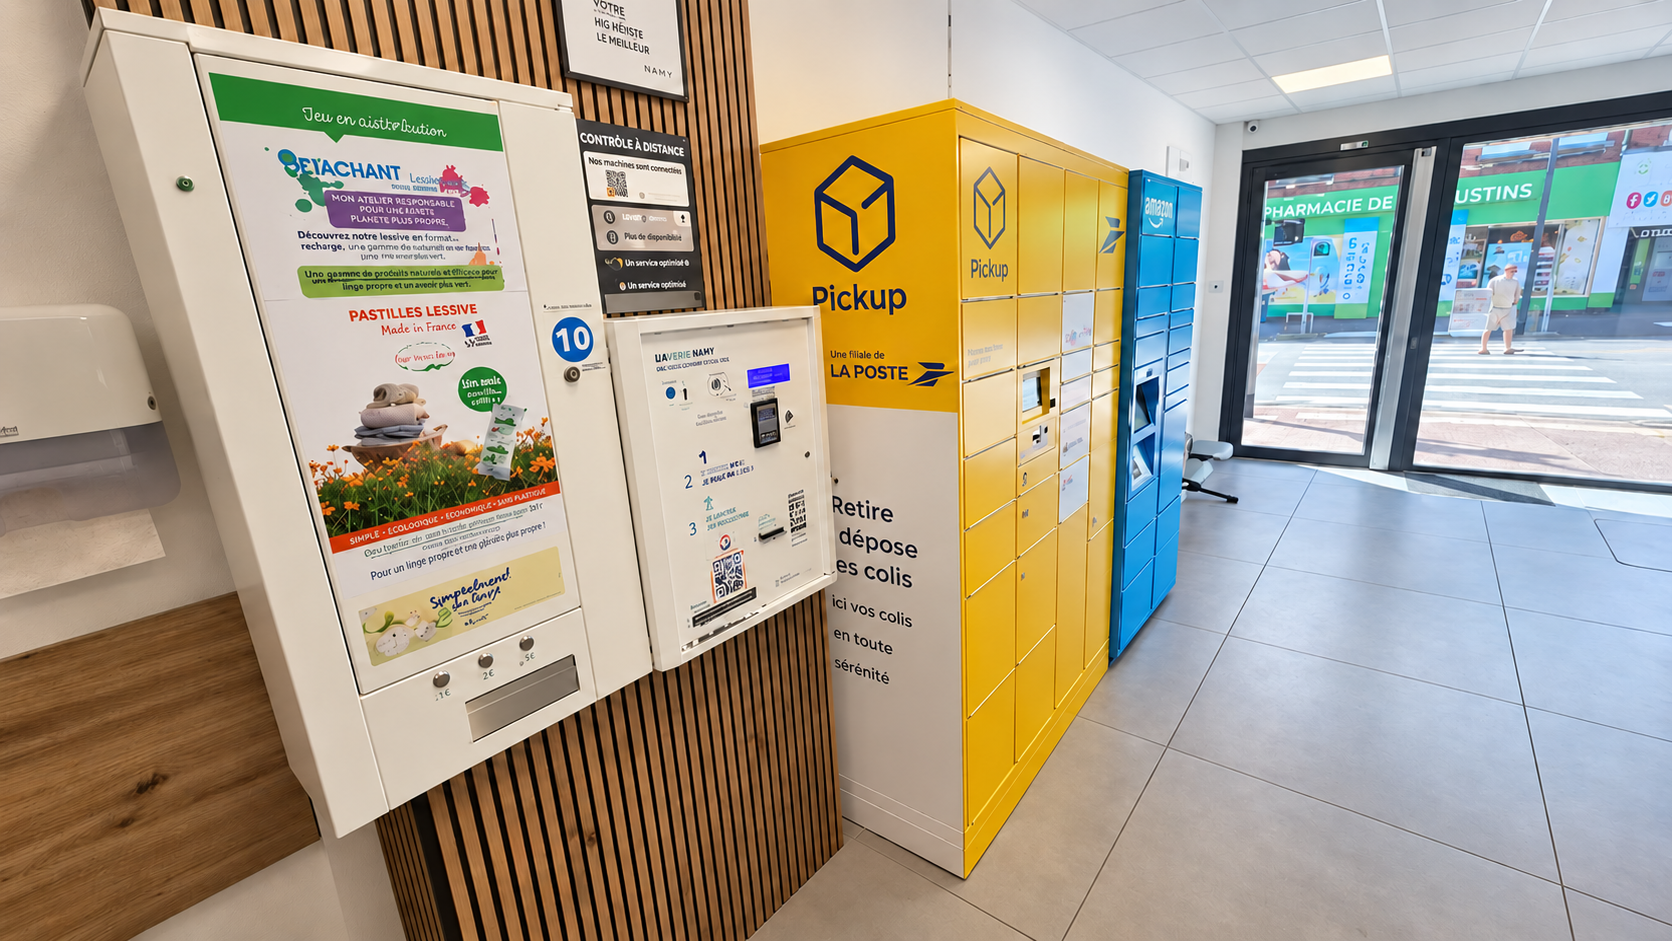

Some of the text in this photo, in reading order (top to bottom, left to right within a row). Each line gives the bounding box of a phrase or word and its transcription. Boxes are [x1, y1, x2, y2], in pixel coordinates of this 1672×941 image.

[593, 0, 625, 16] VOTRE
[596, 32, 650, 55] LE MEILLEUR
[644, 65, 672, 78] NAMY
[336, 114, 356, 126] en
[580, 132, 685, 157] CONTRÔLE À DISTANCE
[588, 156, 602, 166] Nos
[604, 160, 635, 170] machines
[636, 163, 650, 171] sont
[331, 194, 355, 203] MON
[358, 196, 393, 205] ATELIER
[1265, 196, 1394, 218] PHARMACIE DE
[360, 206, 384, 214] POUR
[1145, 197, 1173, 219] amazon
[297, 230, 350, 240] Découvrez
[380, 232, 410, 241] lessive
[624, 232, 637, 240] Plus
[625, 259, 634, 267] Un
[636, 259, 658, 267] service
[971, 258, 1008, 282] Pickup
[366, 283, 393, 291] propre
[628, 282, 638, 290] Un
[638, 281, 660, 289] service
[812, 284, 907, 316] Pickup
[349, 303, 478, 322] PASTILLES LESSIVE
[381, 321, 457, 336] Made in France
[555, 326, 590, 352] 10
[830, 350, 885, 359] Une filiale de
[830, 364, 908, 381] LA POSTE
[698, 450, 707, 464] 1
[684, 474, 693, 489] 2
[832, 495, 894, 522] Retire
[688, 522, 697, 536] 3
[350, 530, 380, 545] SIMPLE
[839, 527, 918, 558] dépose
[393, 564, 405, 574] un
[405, 558, 427, 570] linge
[864, 566, 913, 588] colis
[832, 594, 913, 628] ici vos colis
[834, 629, 893, 655] en toute
[525, 652, 535, 662] 5€
[482, 669, 495, 680] 2€
[834, 658, 890, 685] sérénité
